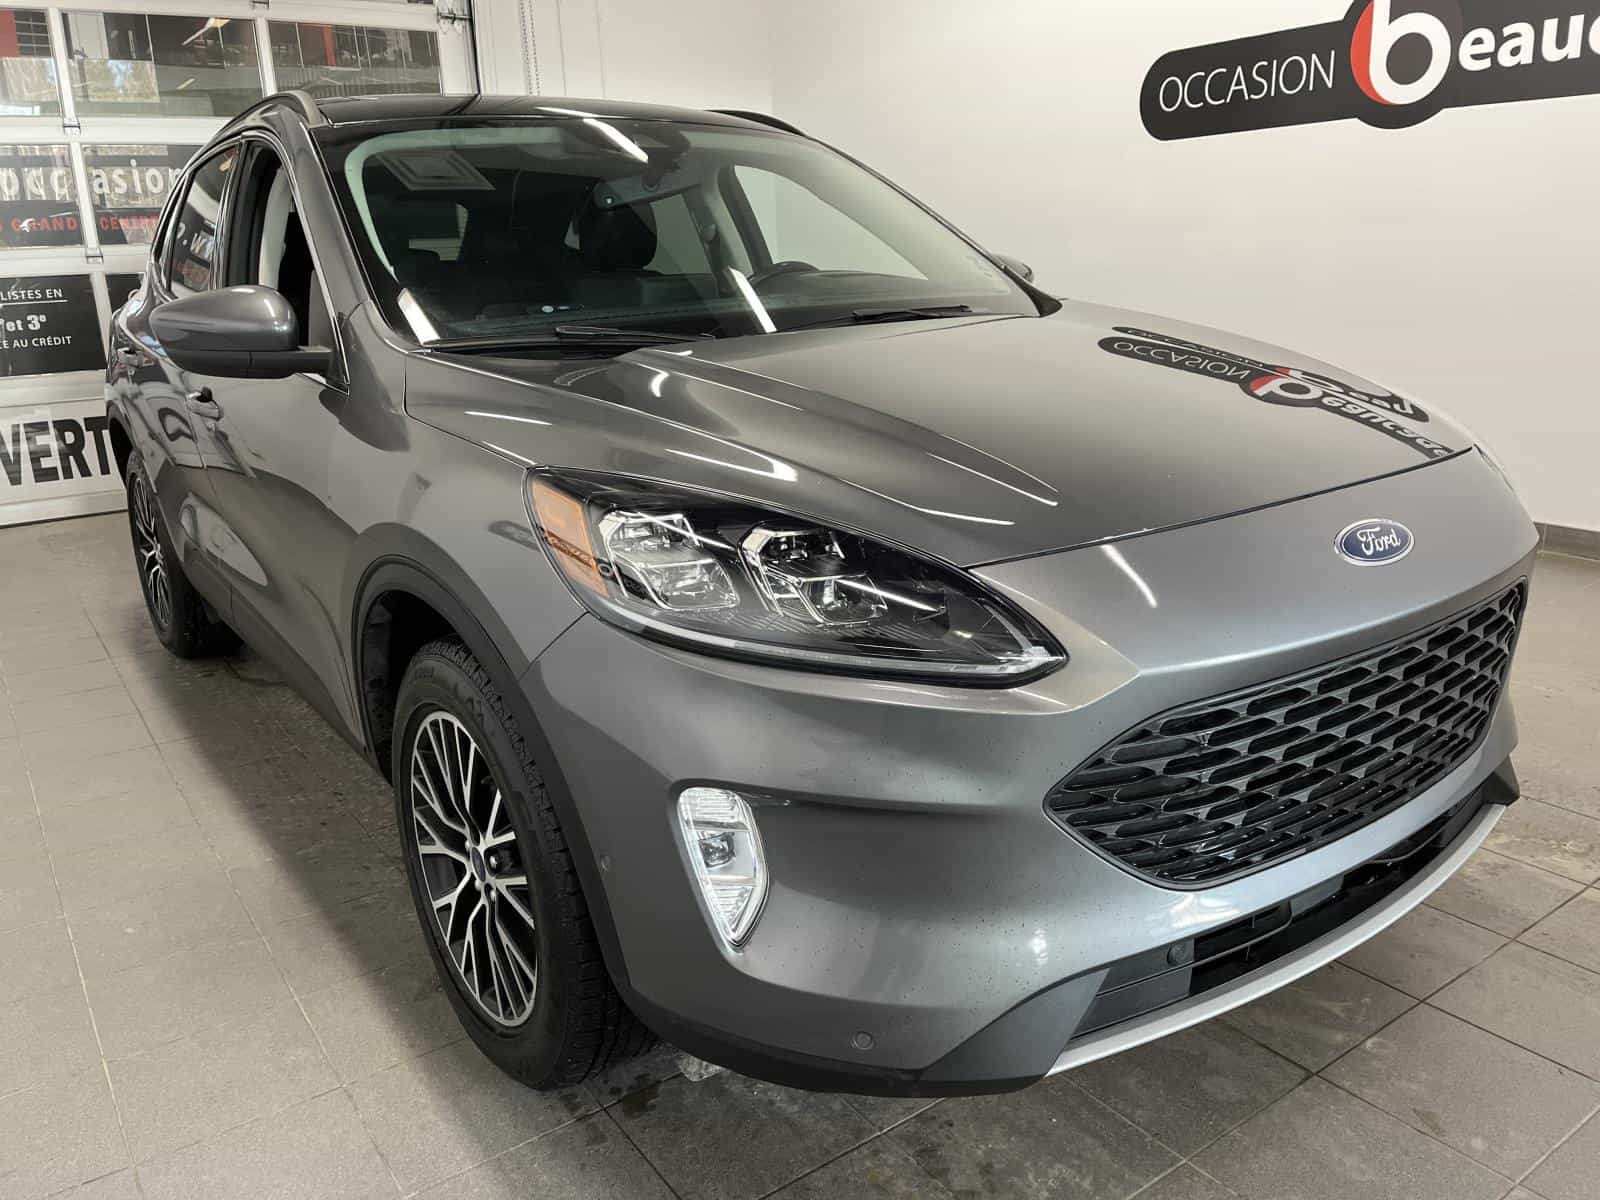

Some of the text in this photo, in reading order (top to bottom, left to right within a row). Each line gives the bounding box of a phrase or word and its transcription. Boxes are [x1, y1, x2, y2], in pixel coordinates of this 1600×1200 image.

[1158, 50, 1336, 113] OCCASION
[0, 288, 63, 302] LISTES EN
[5, 319, 24, 332] et
[13, 338, 29, 349] AU
[31, 335, 73, 347] CRÉDIT
[0, 415, 111, 486] VERT
[1356, 526, 1402, 556] Ford
